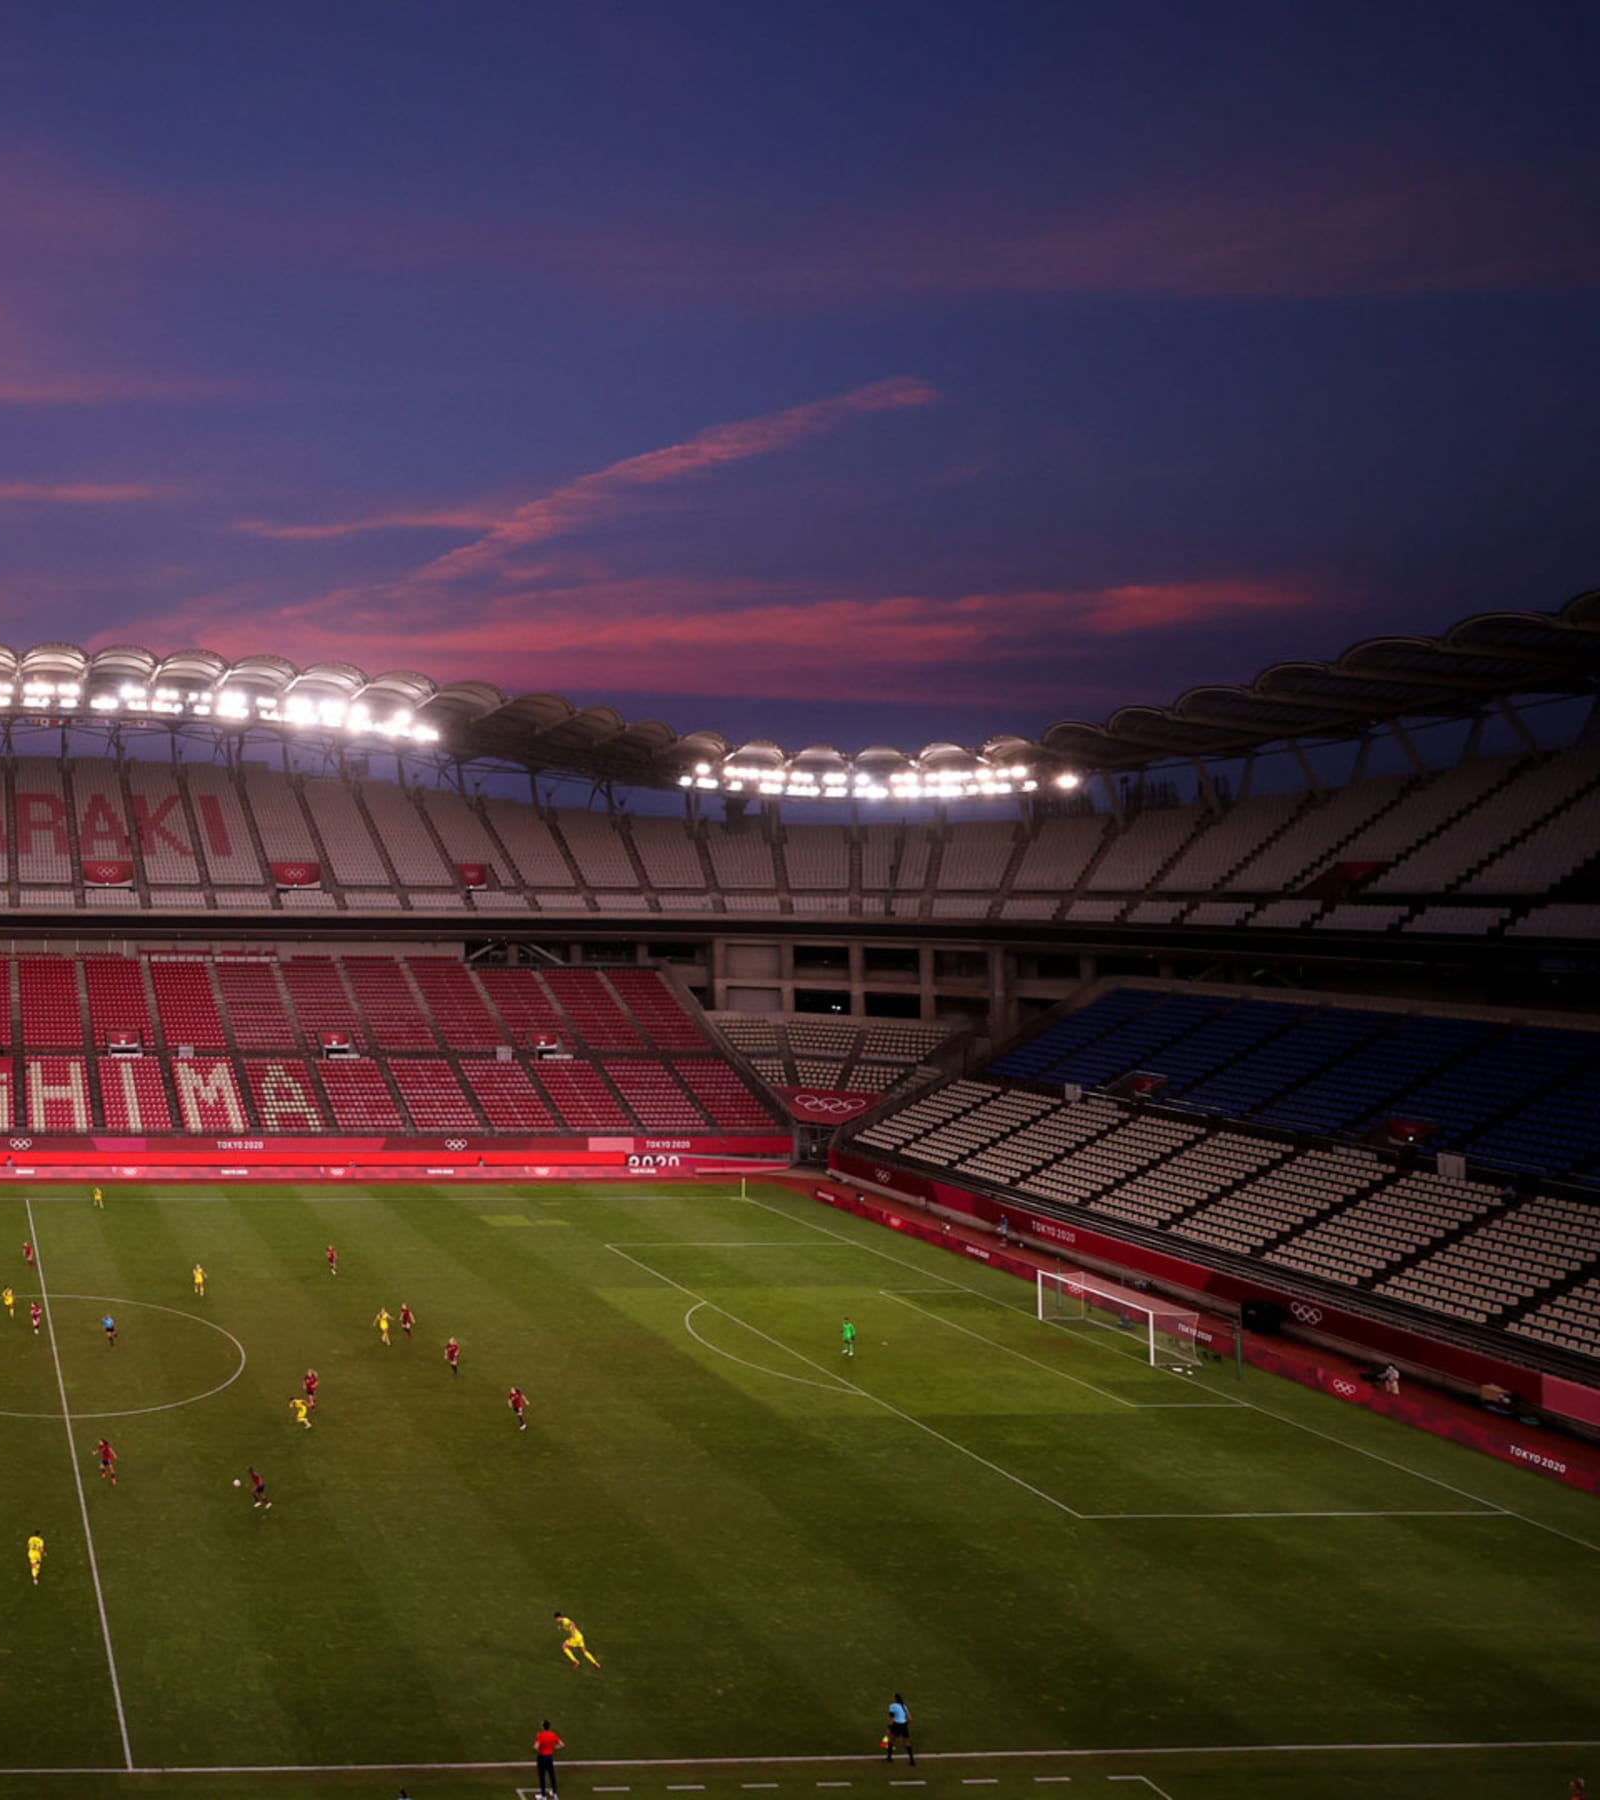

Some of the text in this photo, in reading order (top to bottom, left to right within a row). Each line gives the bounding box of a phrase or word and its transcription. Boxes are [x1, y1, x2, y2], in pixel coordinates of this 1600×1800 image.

[216, 1140, 264, 1150] TOKYO 2020
[645, 1140, 671, 1149] TOKYO
[1031, 1220, 1076, 1243] TOKYO 2020
[1509, 1444, 1567, 1474] TOKYO 2020
